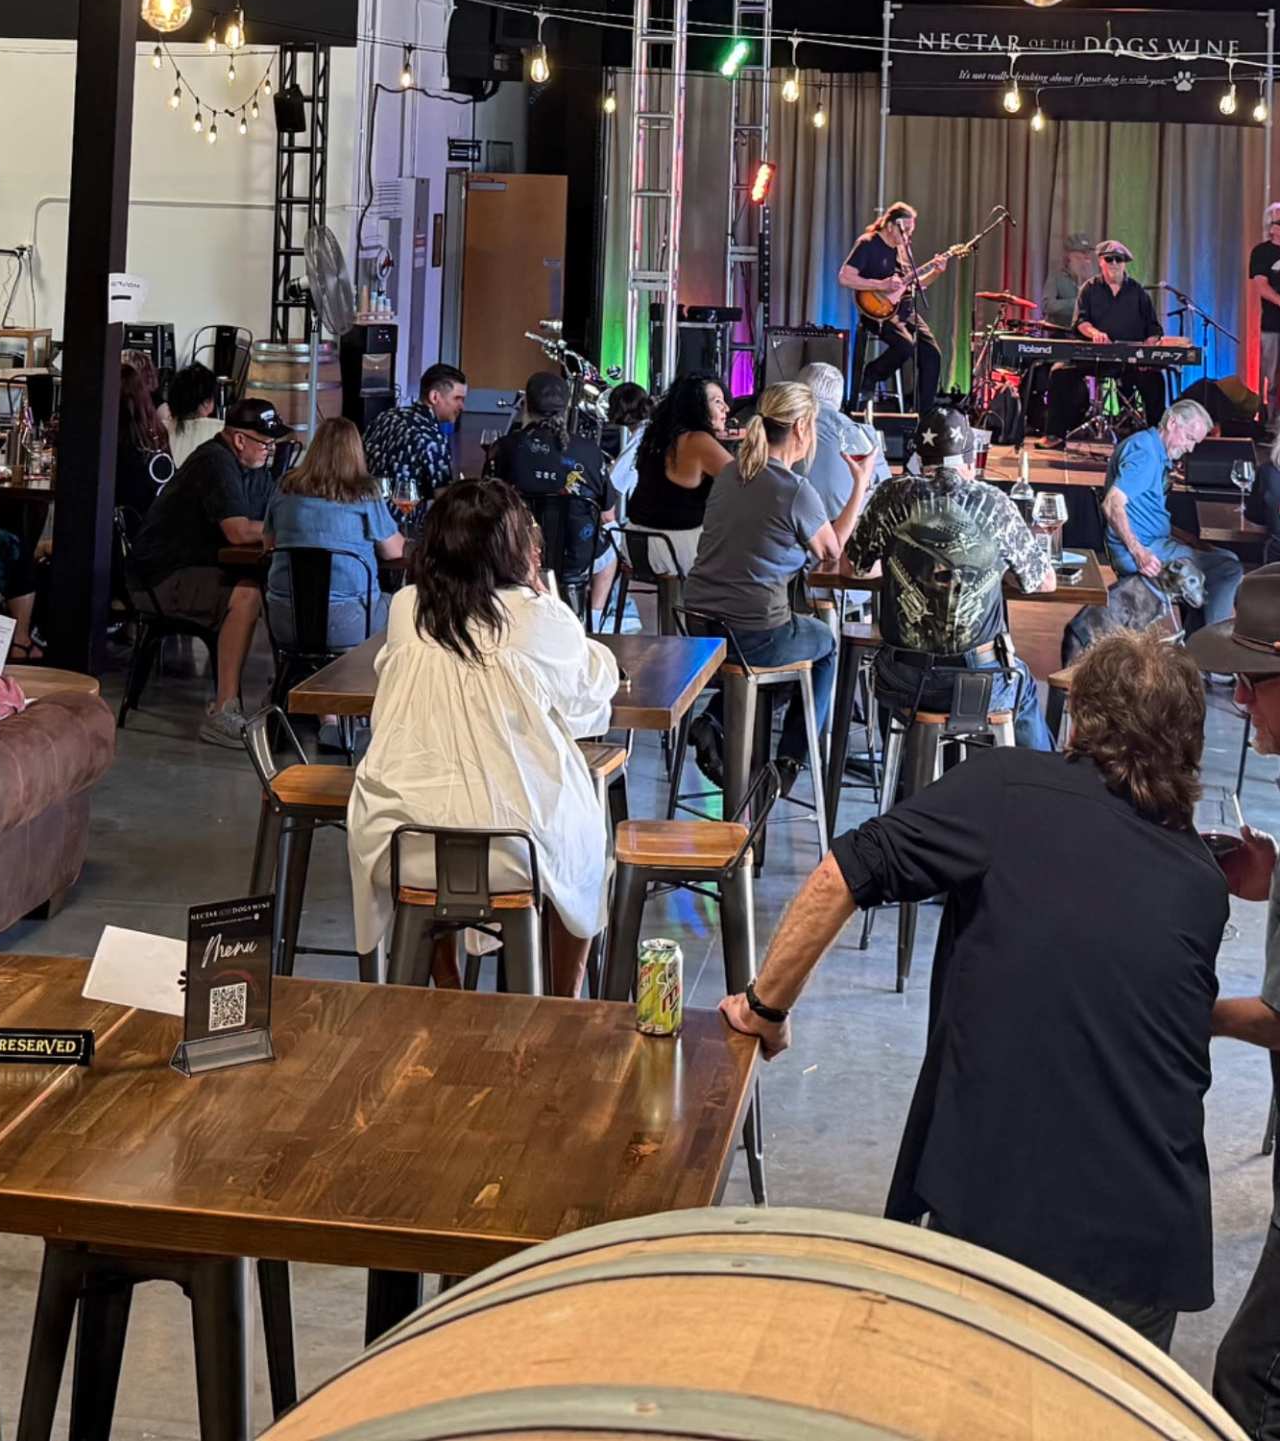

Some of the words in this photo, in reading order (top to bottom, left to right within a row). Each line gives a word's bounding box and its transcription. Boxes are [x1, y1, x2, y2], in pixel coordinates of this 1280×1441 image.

[918, 32, 1020, 52] NECTAR
[1028, 39, 1045, 48] OF
[1053, 39, 1077, 49] THE
[1084, 36, 1158, 53] DOGS
[1167, 38, 1240, 56] WINE
[959, 69, 970, 79] It's
[972, 71, 986, 79] not
[1050, 72, 1072, 82] alone
[1103, 74, 1119, 86] dog
[1018, 343, 1052, 354] Roland
[1151, 350, 1183, 360] FP-7
[201, 931, 258, 969] Menu
